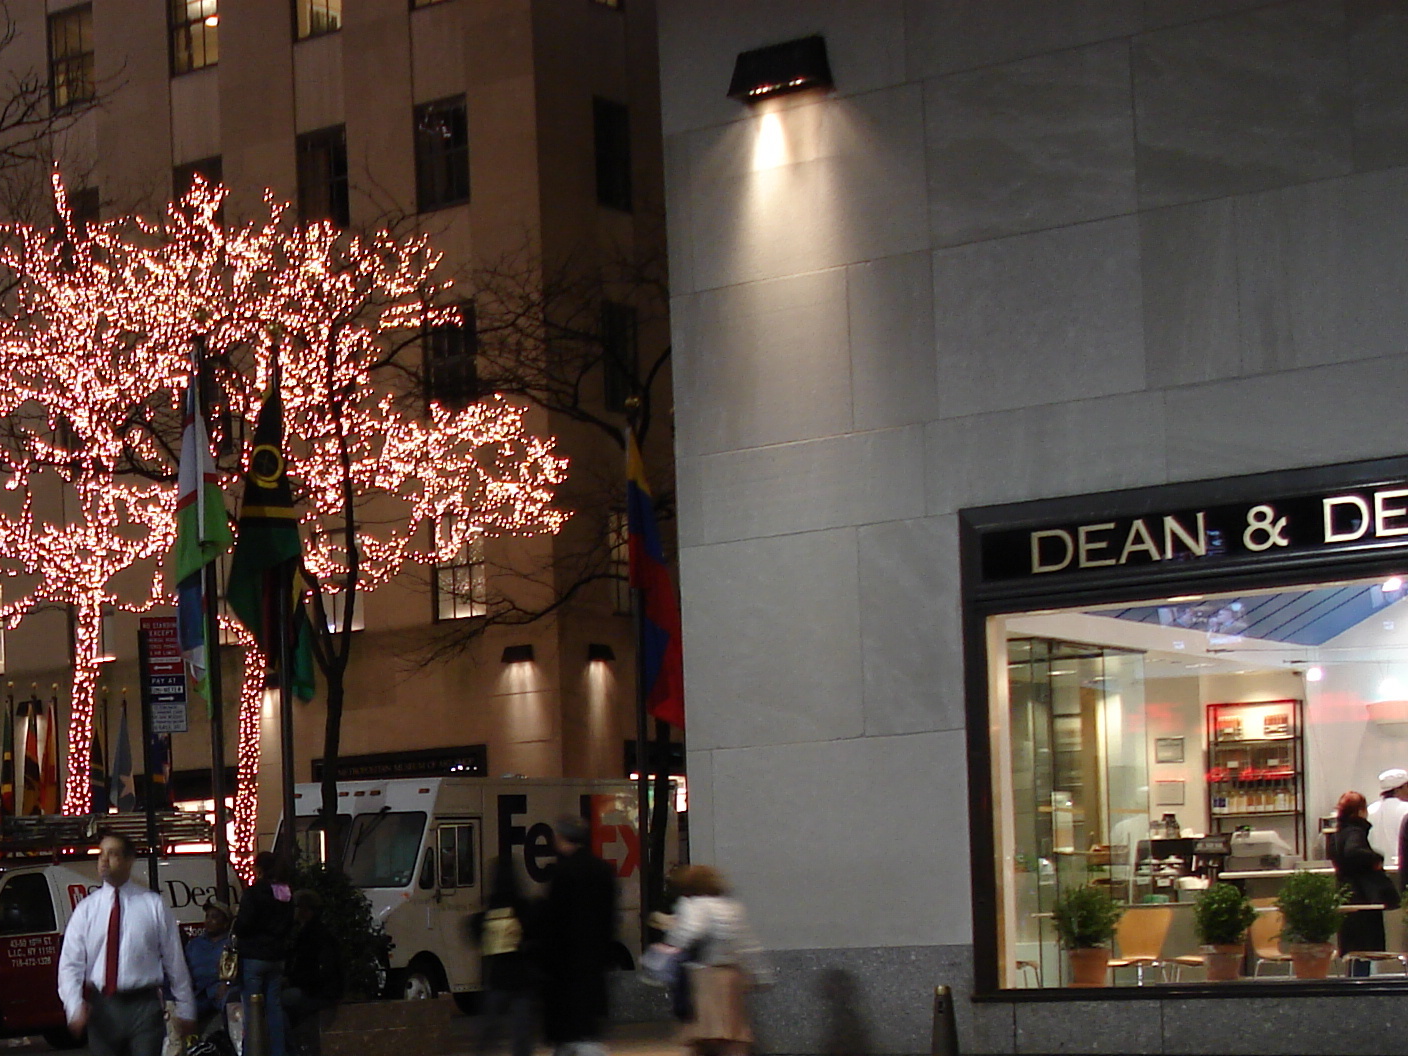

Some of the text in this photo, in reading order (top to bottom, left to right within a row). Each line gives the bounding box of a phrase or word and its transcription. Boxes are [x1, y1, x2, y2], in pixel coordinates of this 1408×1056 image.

[1030, 512, 1207, 574] DEAN
[1243, 505, 1289, 551] &
[497, 794, 641, 883] FeEx
